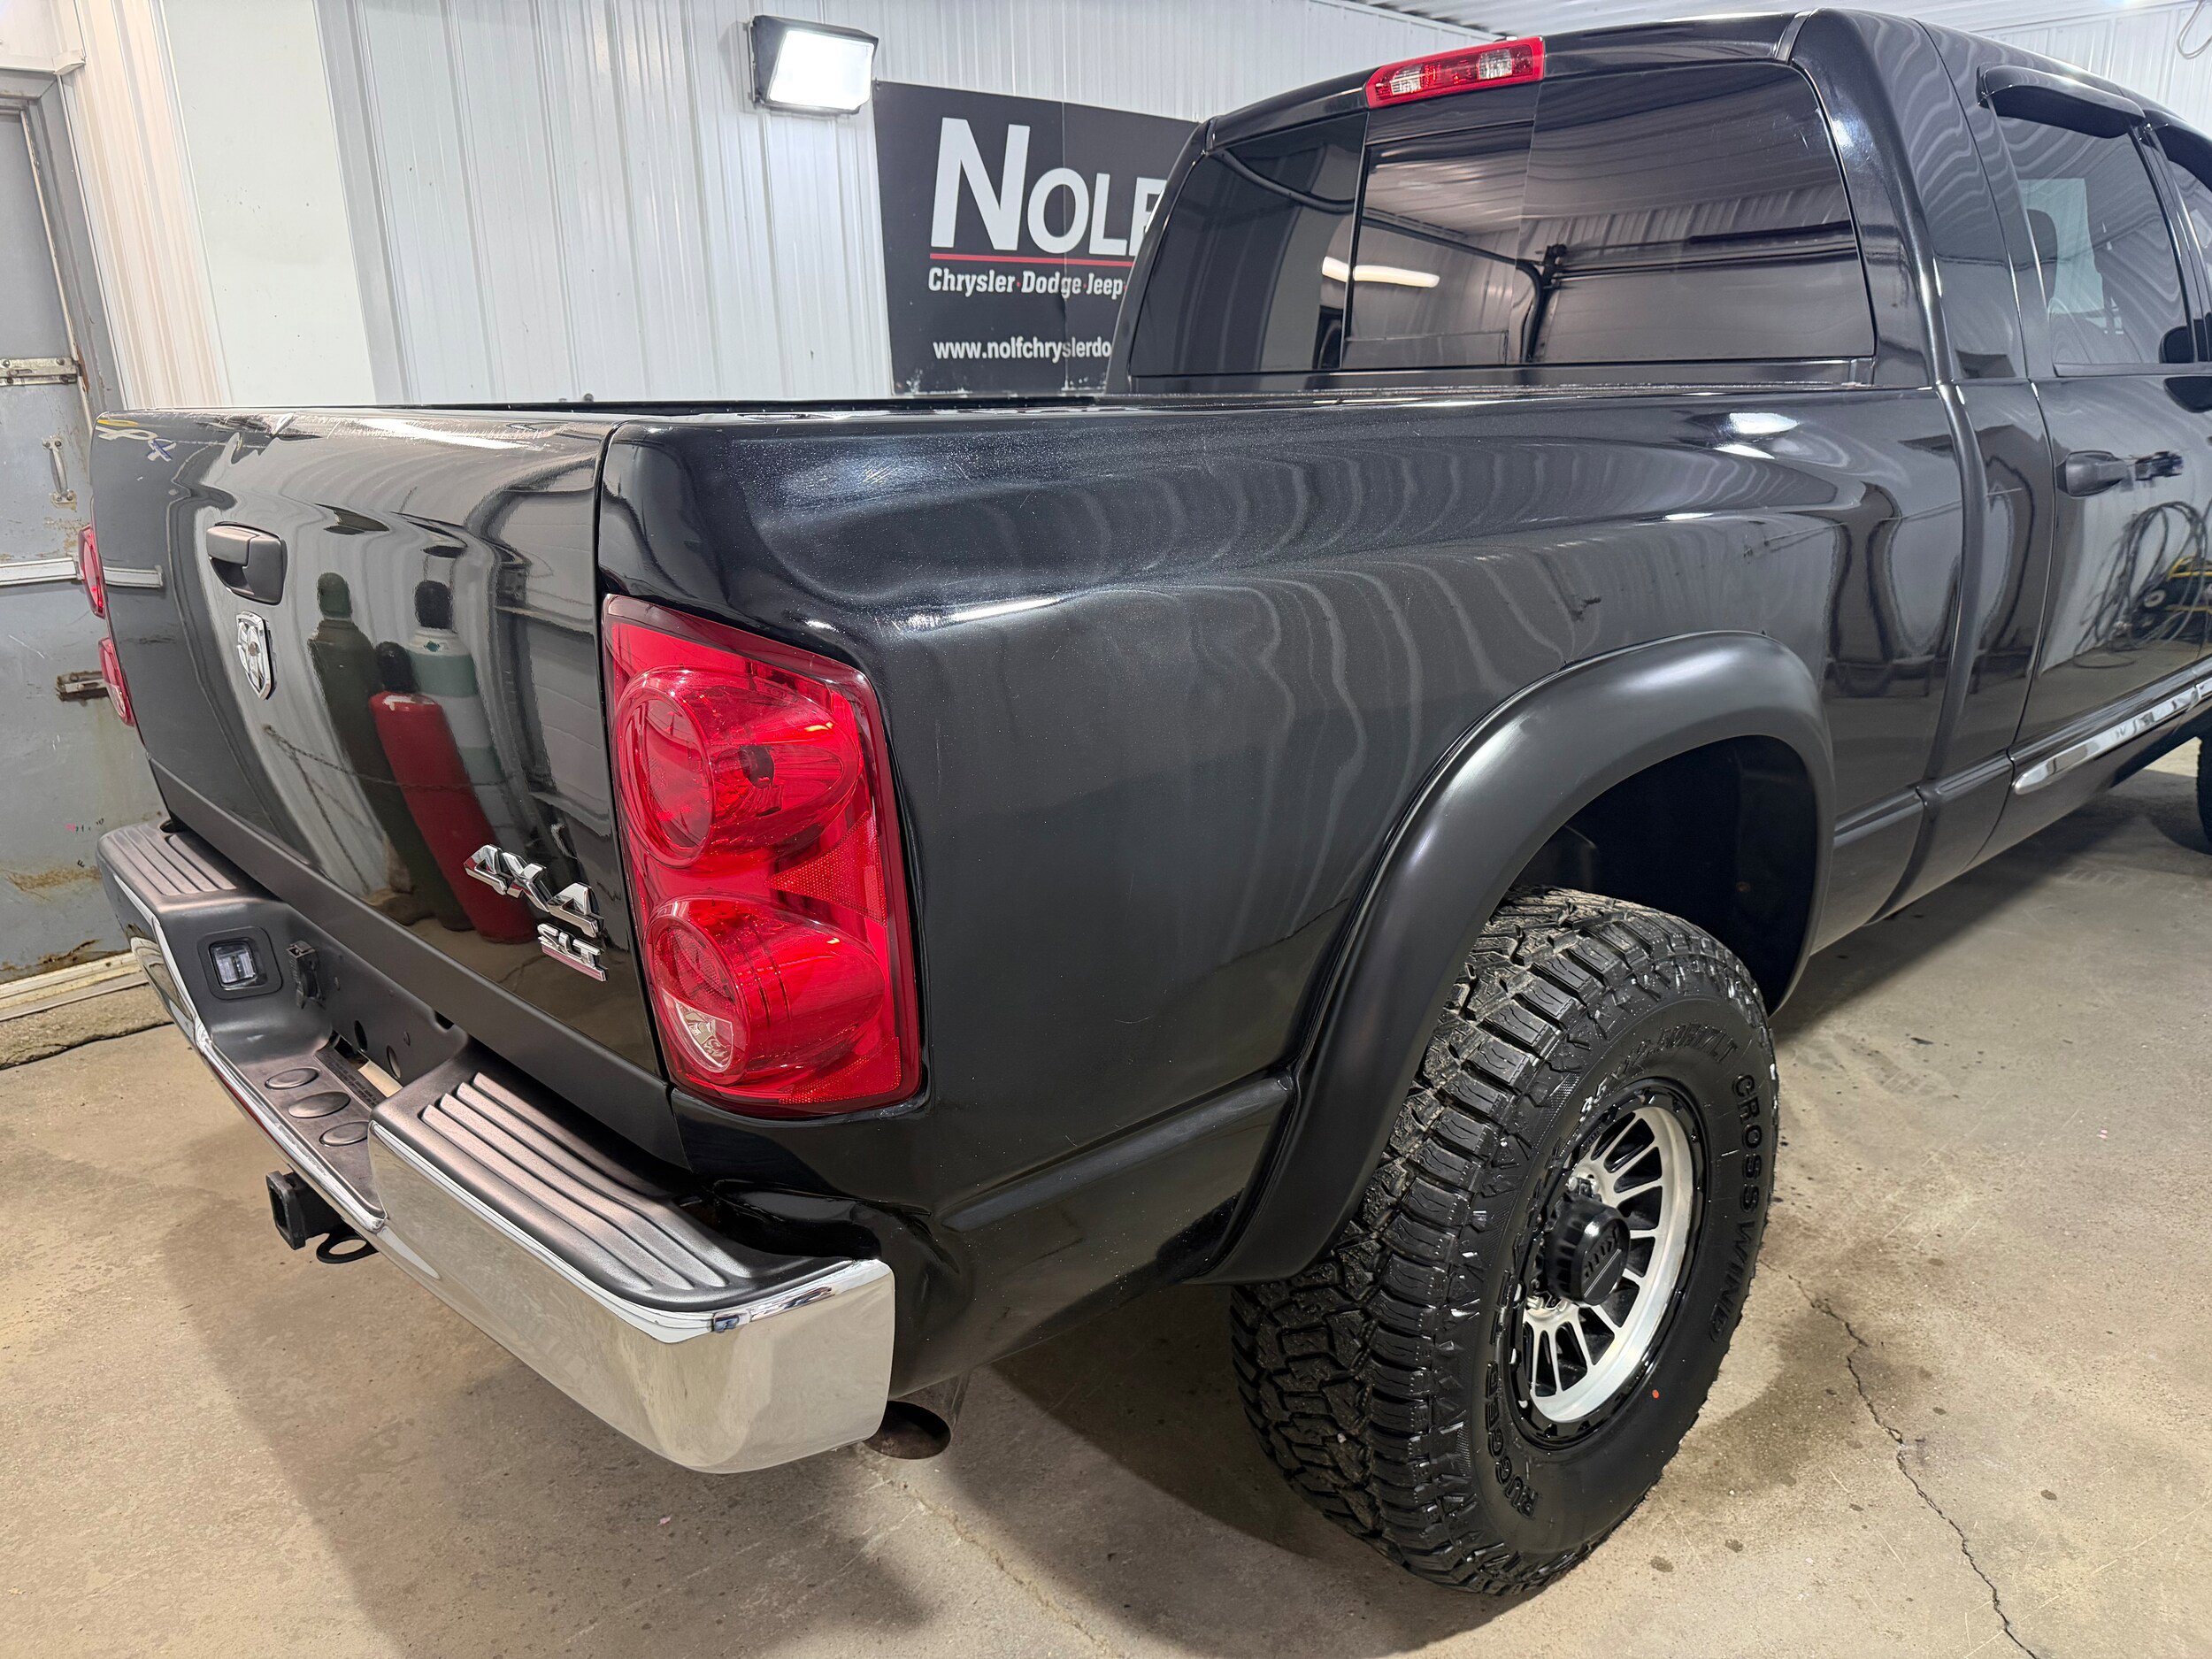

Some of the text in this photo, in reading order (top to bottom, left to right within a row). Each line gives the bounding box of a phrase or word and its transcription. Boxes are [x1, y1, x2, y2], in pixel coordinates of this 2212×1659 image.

[931, 117, 1167, 256] NOLF
[928, 267, 1124, 300] Chrysler Dodge Jeep
[933, 336, 1112, 363] www.nolfchryslerdo
[537, 923, 604, 969] SLT
[1709, 1074, 1763, 1343] CROSSWIND
[1485, 1362, 1540, 1520] RUGGED
